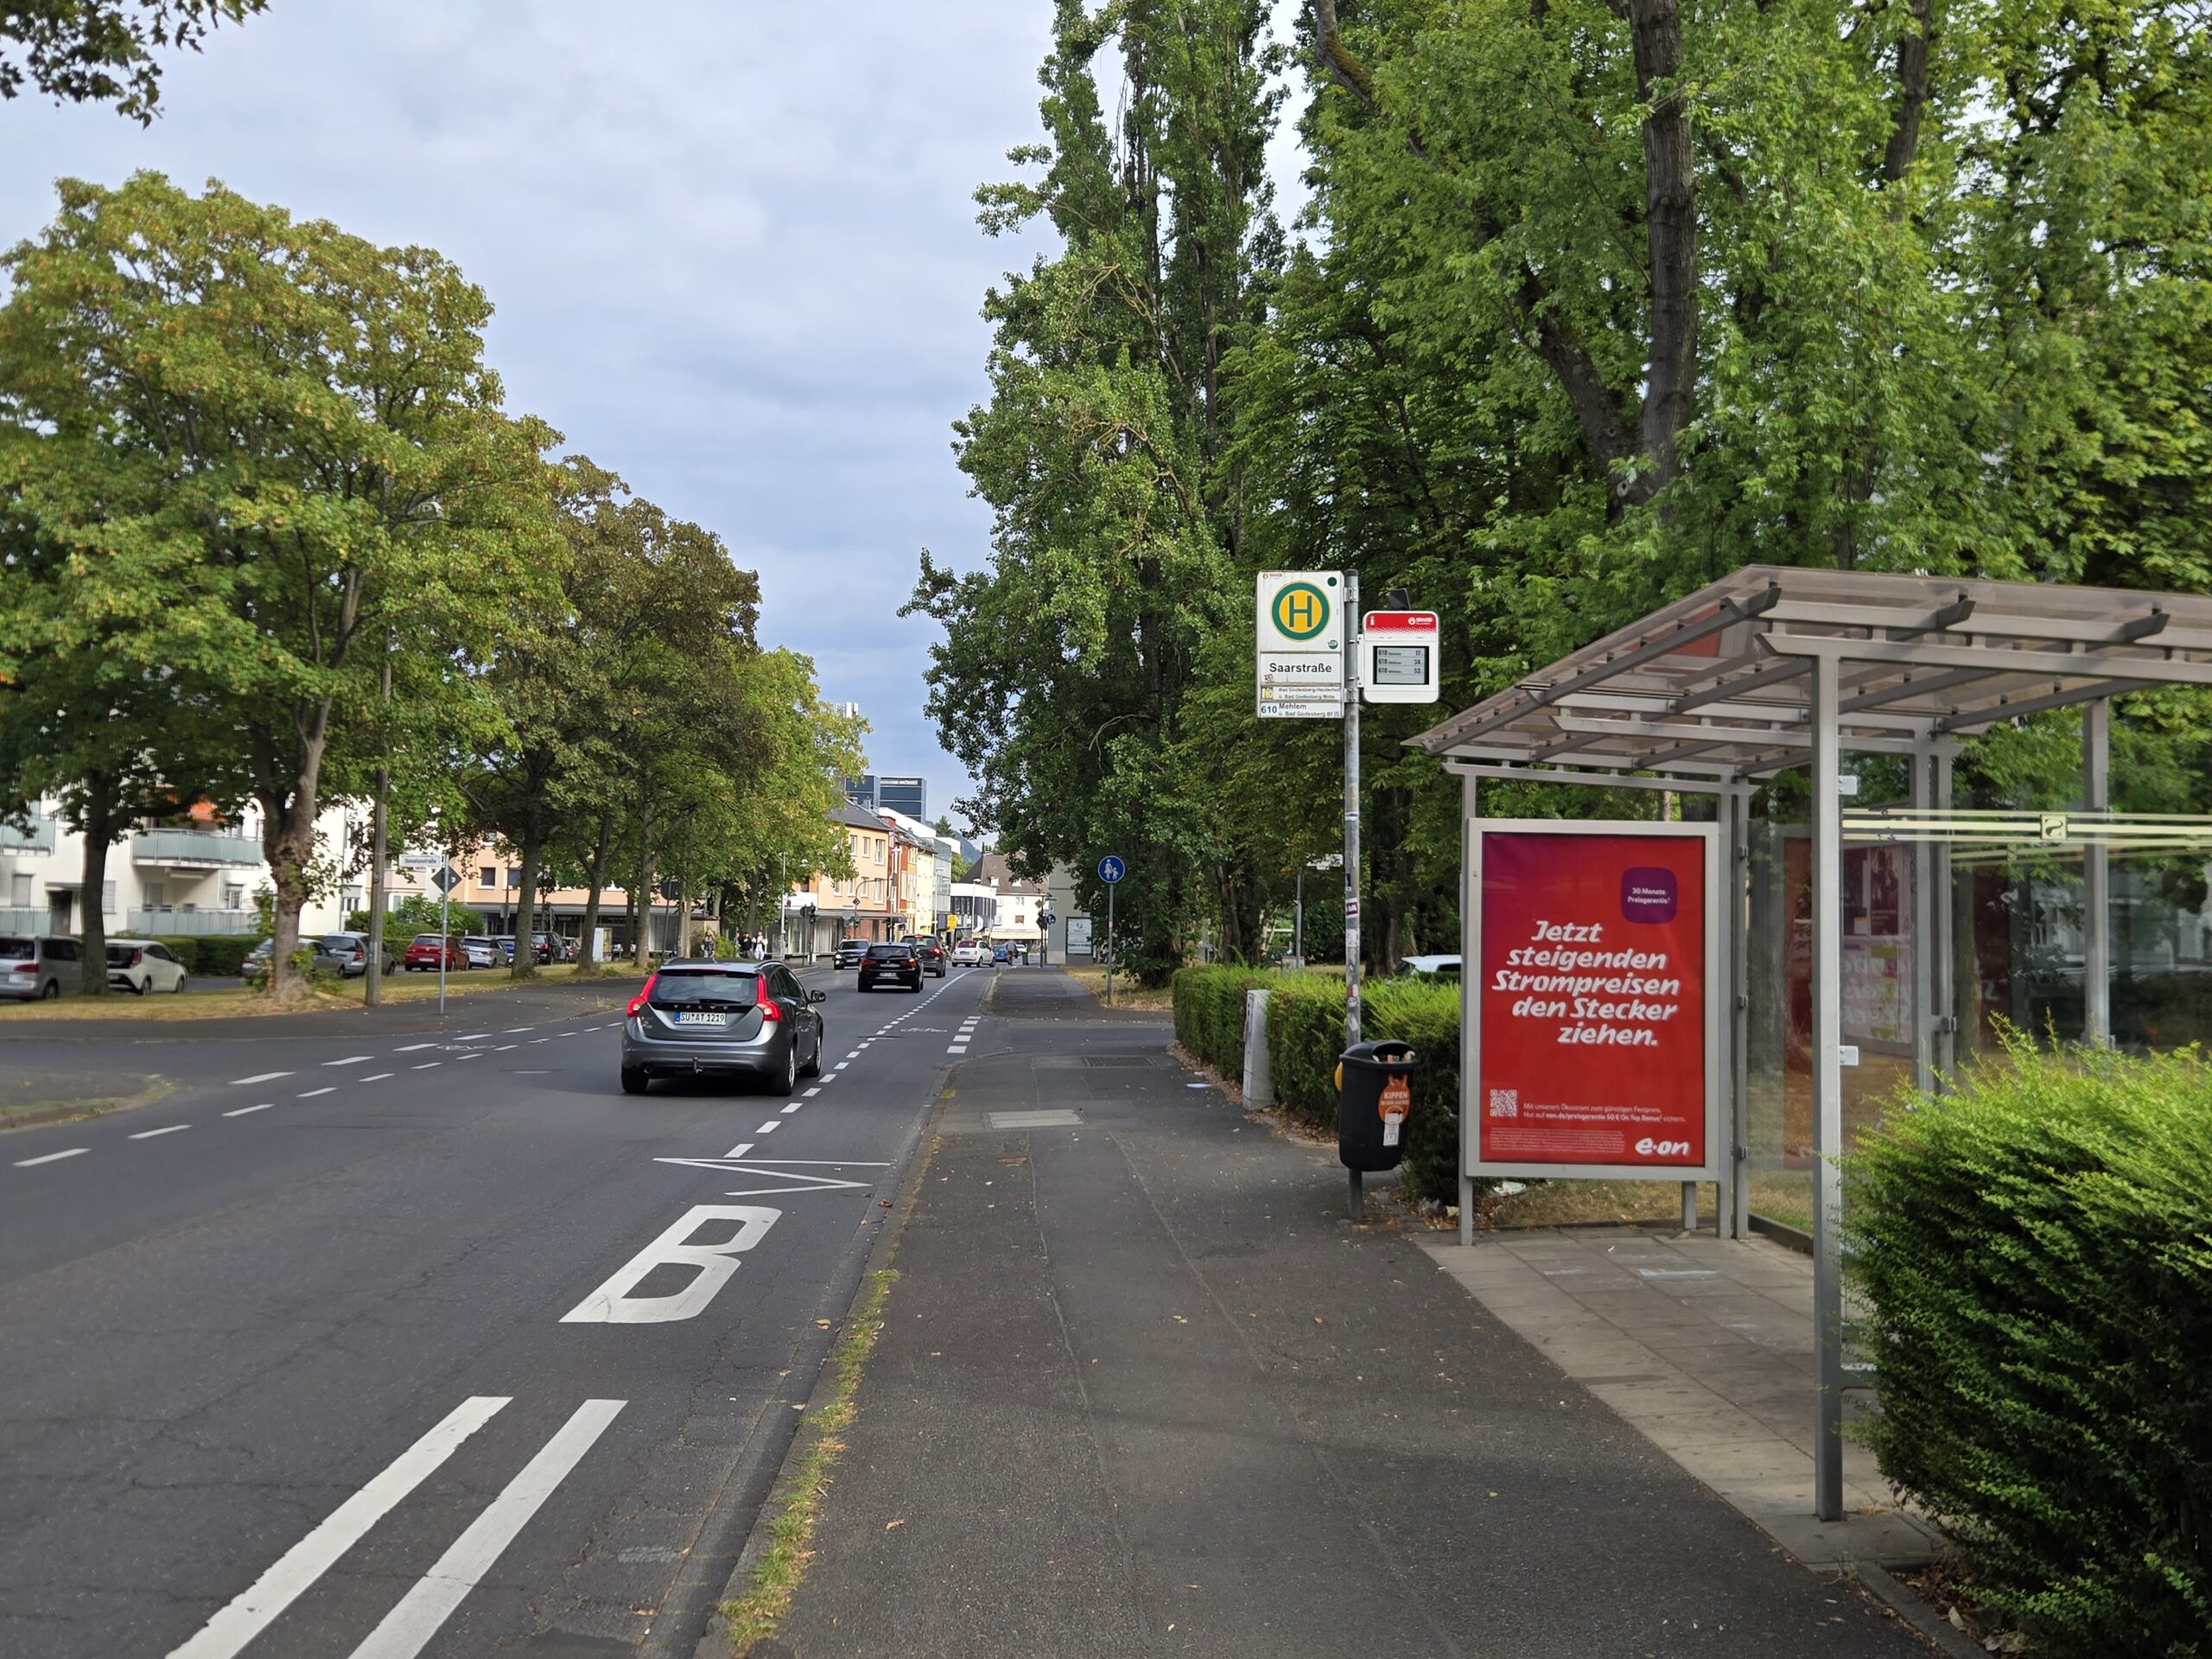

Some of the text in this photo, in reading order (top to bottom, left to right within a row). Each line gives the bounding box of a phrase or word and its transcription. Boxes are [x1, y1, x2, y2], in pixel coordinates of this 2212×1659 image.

[1289, 594, 1313, 627] H
[1269, 662, 1332, 672] Saarstraße
[1261, 705, 1277, 714] 610
[1530, 920, 1603, 942] Jetzt
[1507, 944, 1667, 972] steigenden
[1491, 969, 1681, 997] Strompreisen
[707, 1014, 725, 1022] 1219
[1512, 996, 1679, 1021] den Stecker
[1557, 1021, 1659, 1046] ziehen.
